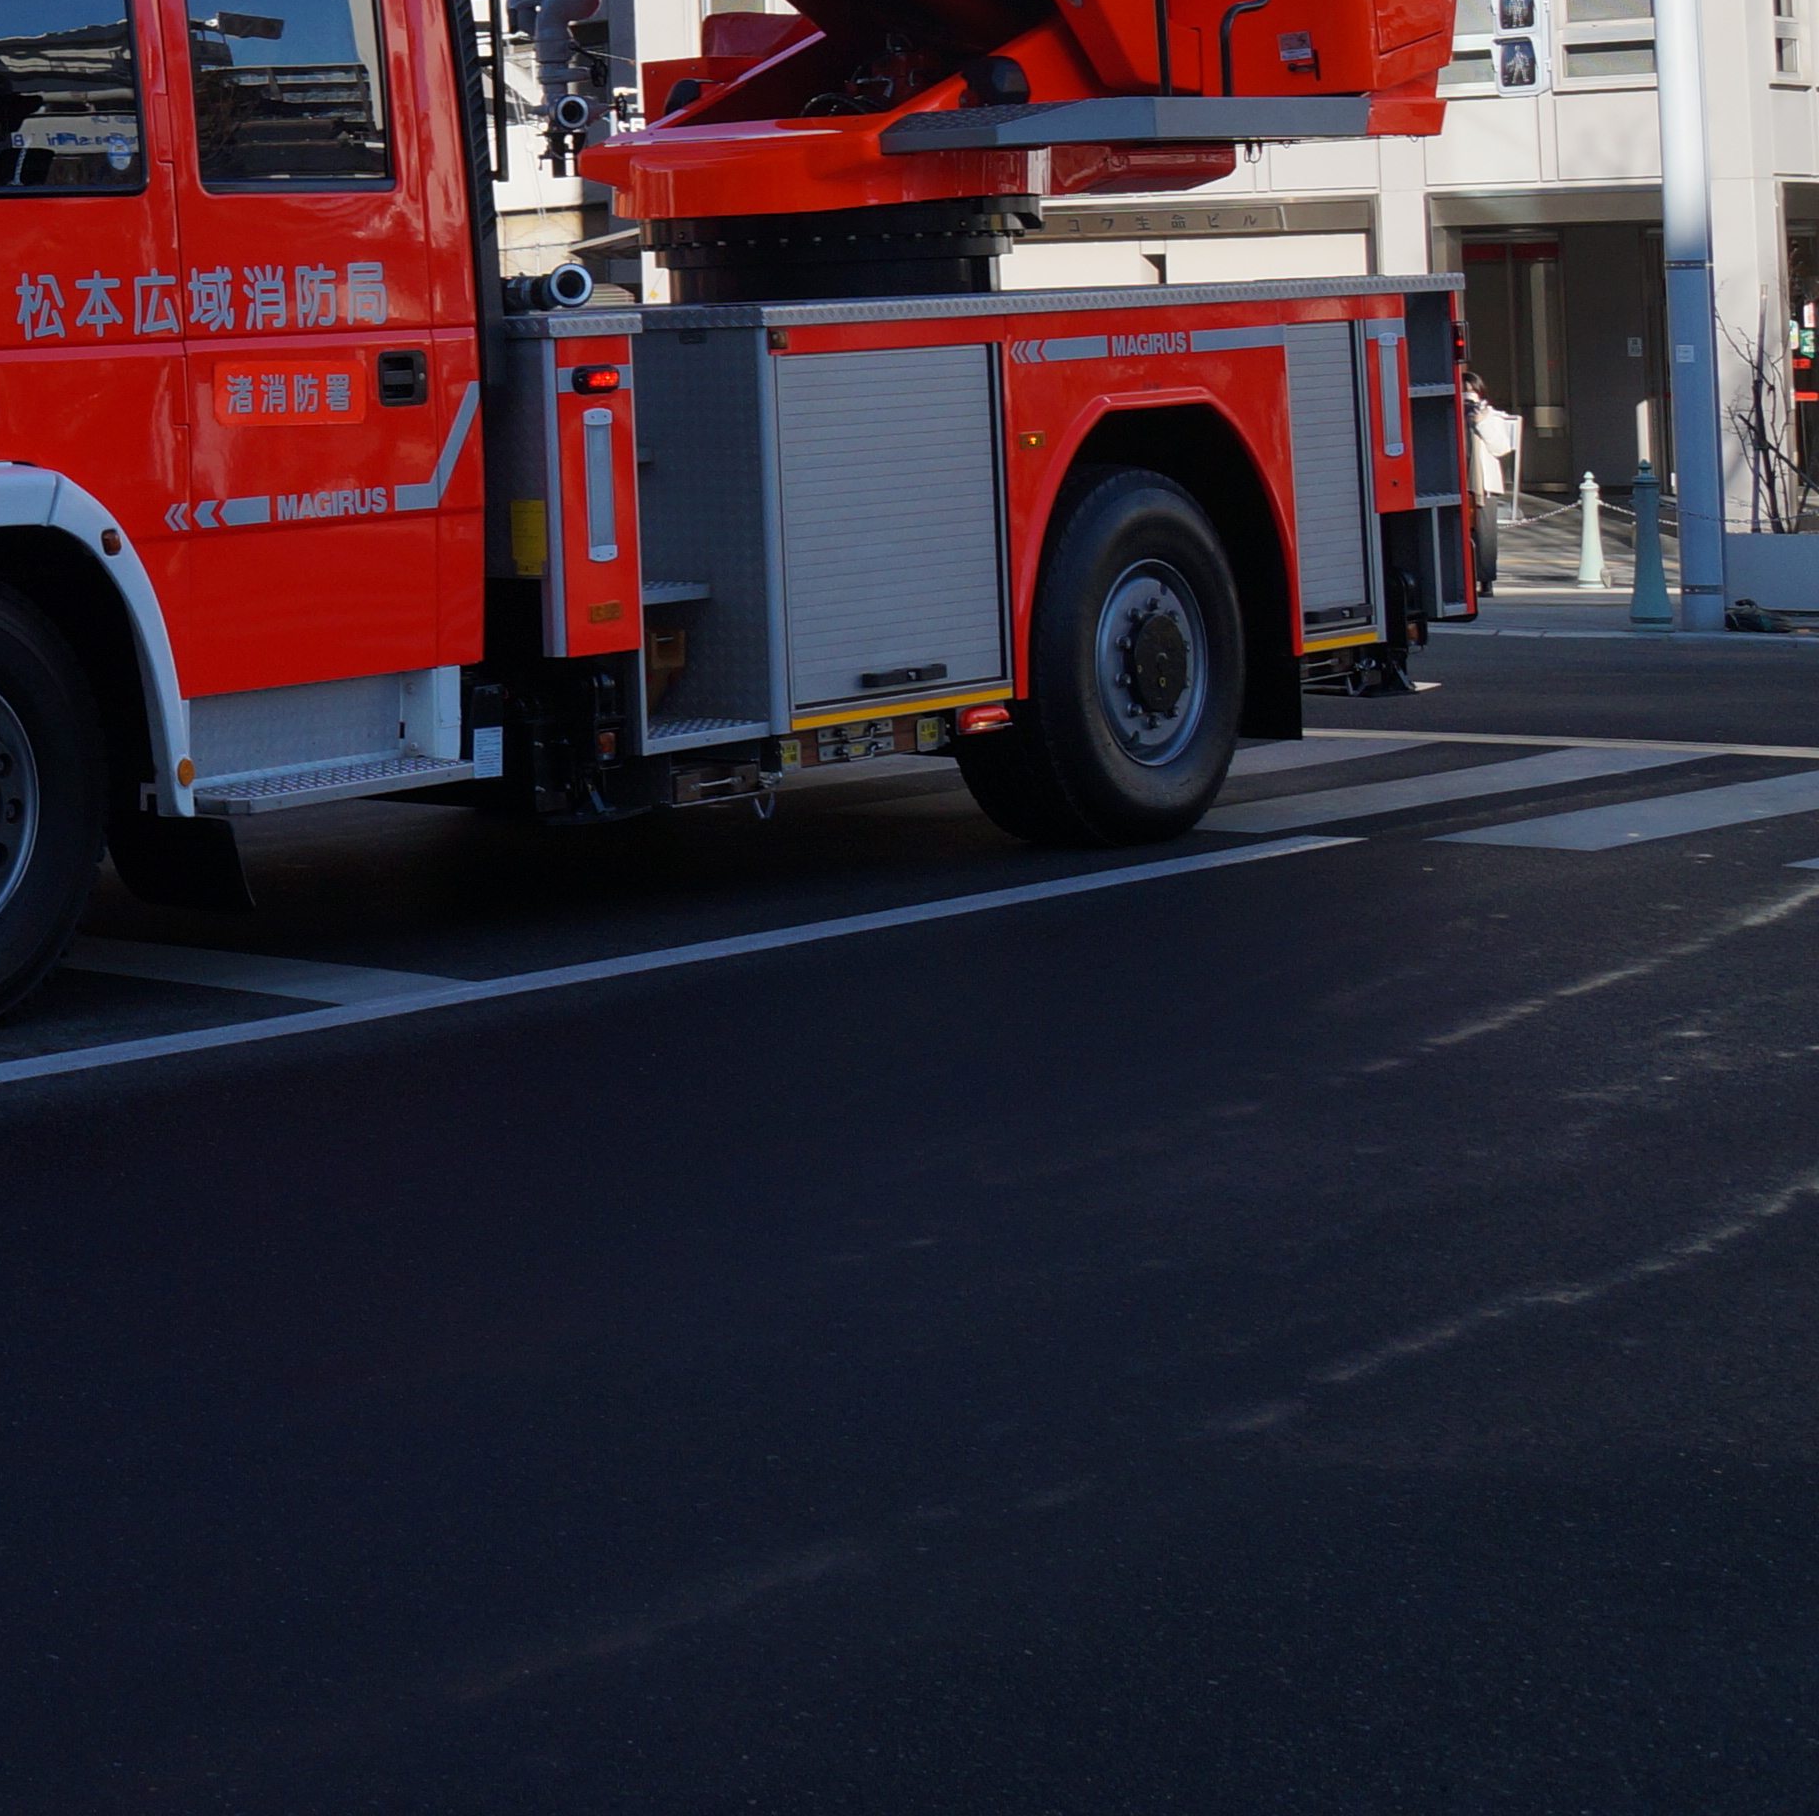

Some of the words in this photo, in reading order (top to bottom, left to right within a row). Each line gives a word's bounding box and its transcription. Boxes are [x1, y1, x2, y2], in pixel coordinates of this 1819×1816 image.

[1039, 213, 1258, 233] コク生命ビル
[15, 262, 389, 341] 松本広域消防局
[1110, 331, 1188, 357] MAGIRUS
[226, 373, 352, 416] 渚消防署
[276, 486, 388, 521] MAGIRUS
